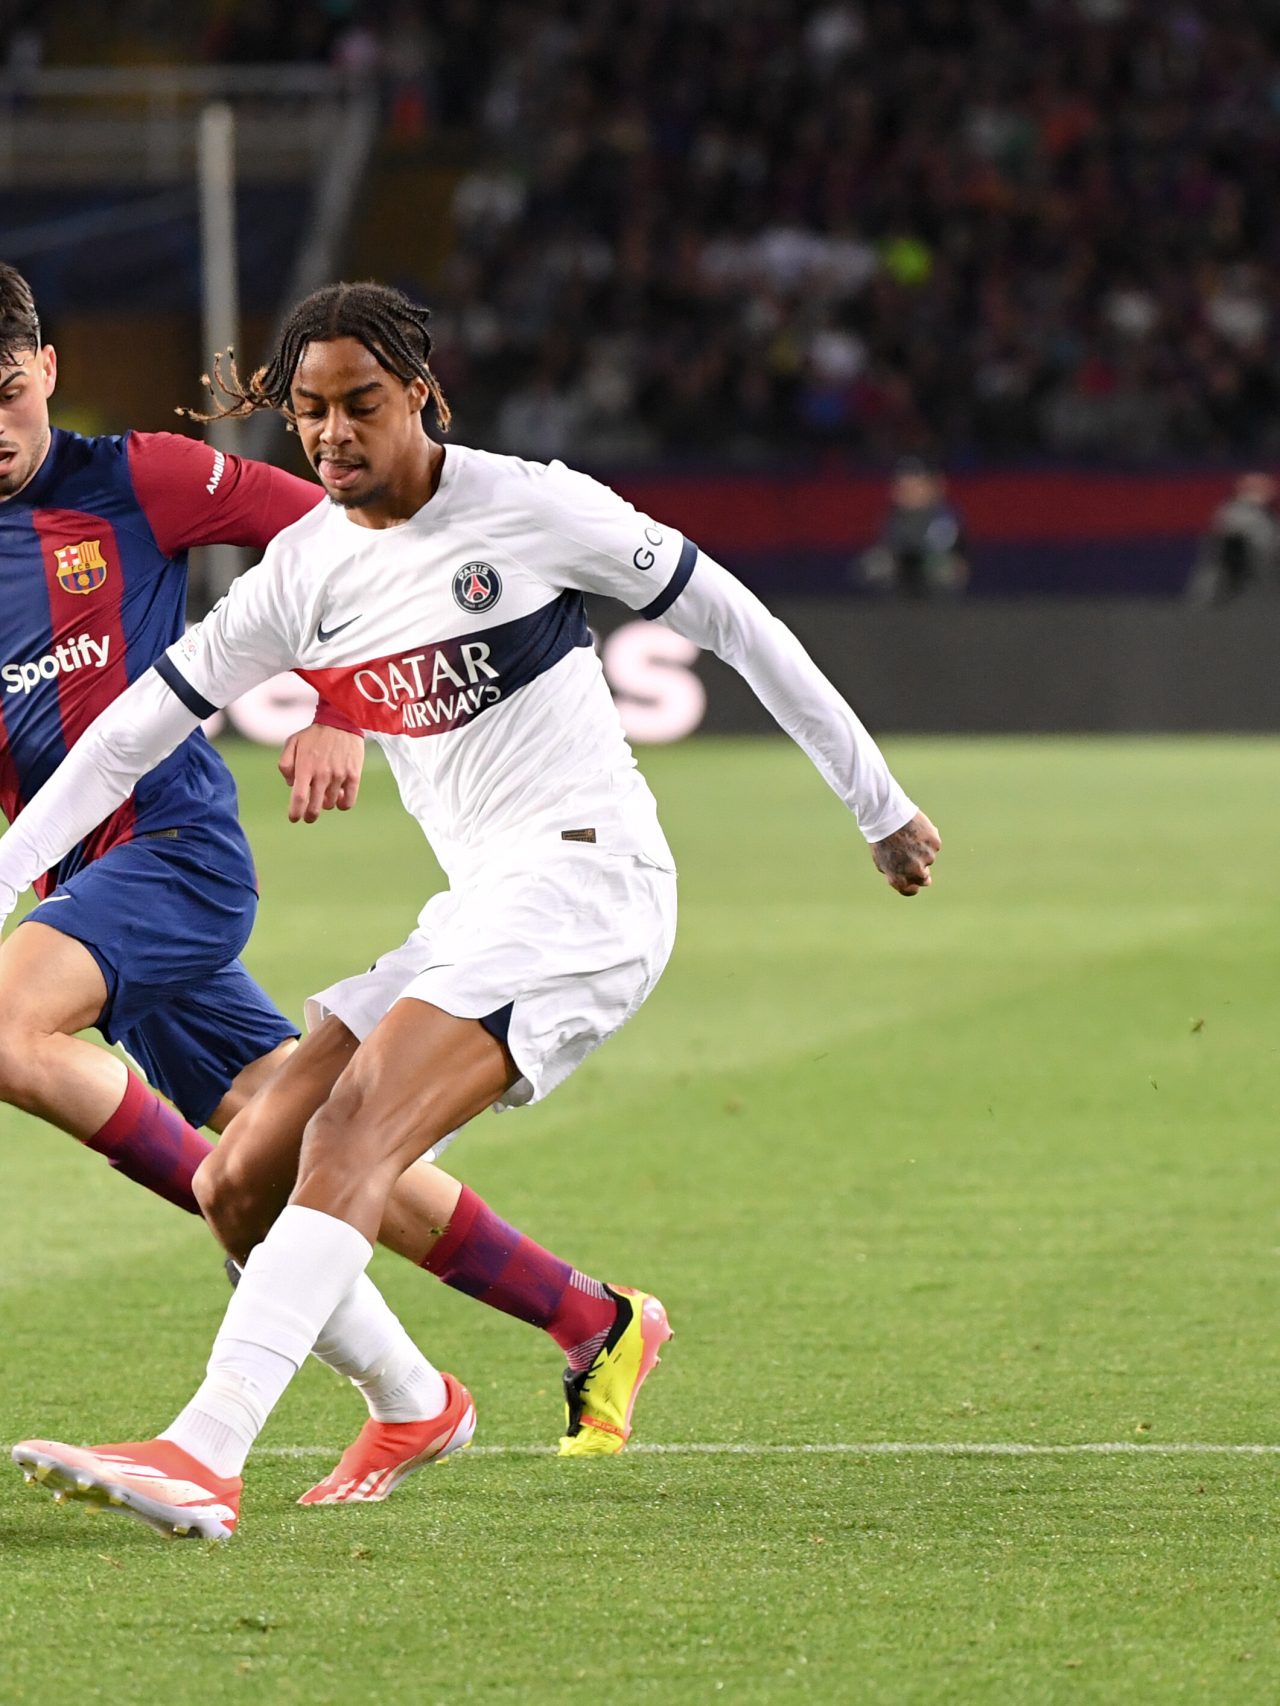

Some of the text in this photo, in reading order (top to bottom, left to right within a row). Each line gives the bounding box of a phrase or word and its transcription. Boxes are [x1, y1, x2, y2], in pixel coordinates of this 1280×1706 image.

[633, 522, 663, 570] GO
[458, 565, 489, 581] PARIS
[1, 633, 110, 695] Spotify
[353, 641, 500, 711] QATAR
[402, 683, 502, 729] AIRWAYS
